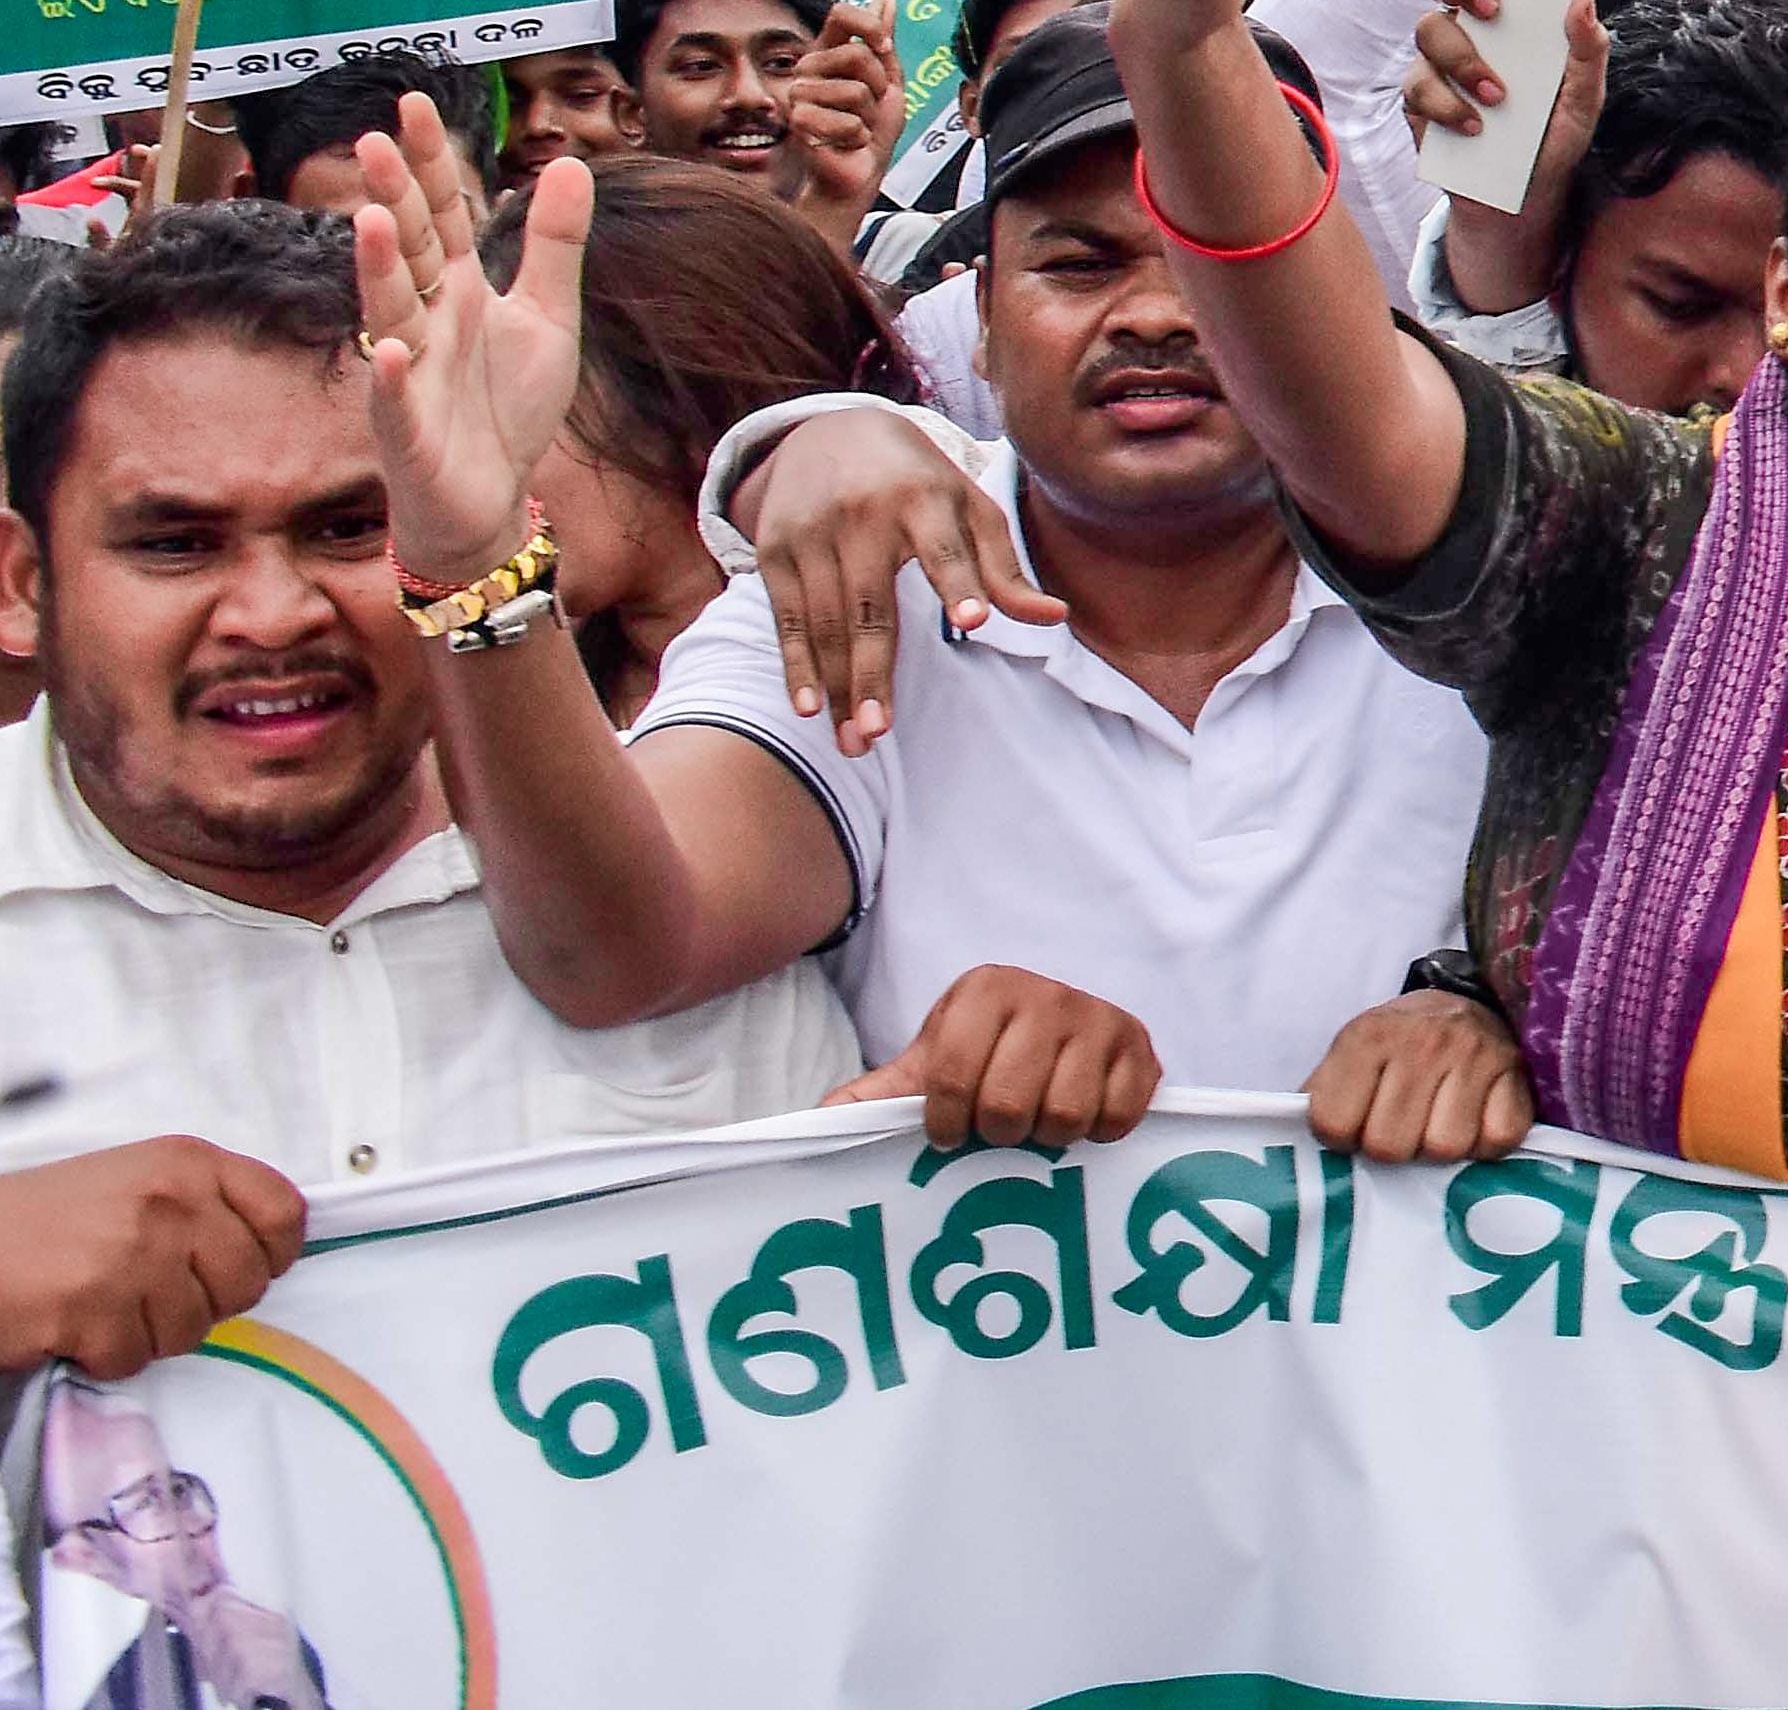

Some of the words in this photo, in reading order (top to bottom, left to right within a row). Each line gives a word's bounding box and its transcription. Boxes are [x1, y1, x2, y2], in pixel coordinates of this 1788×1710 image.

[38, 72, 121, 100] ବିଜୁ
[475, 18, 544, 43] ଦଳ
[493, 1136, 1355, 1480] ଗଣଶିକ୍ଷା
